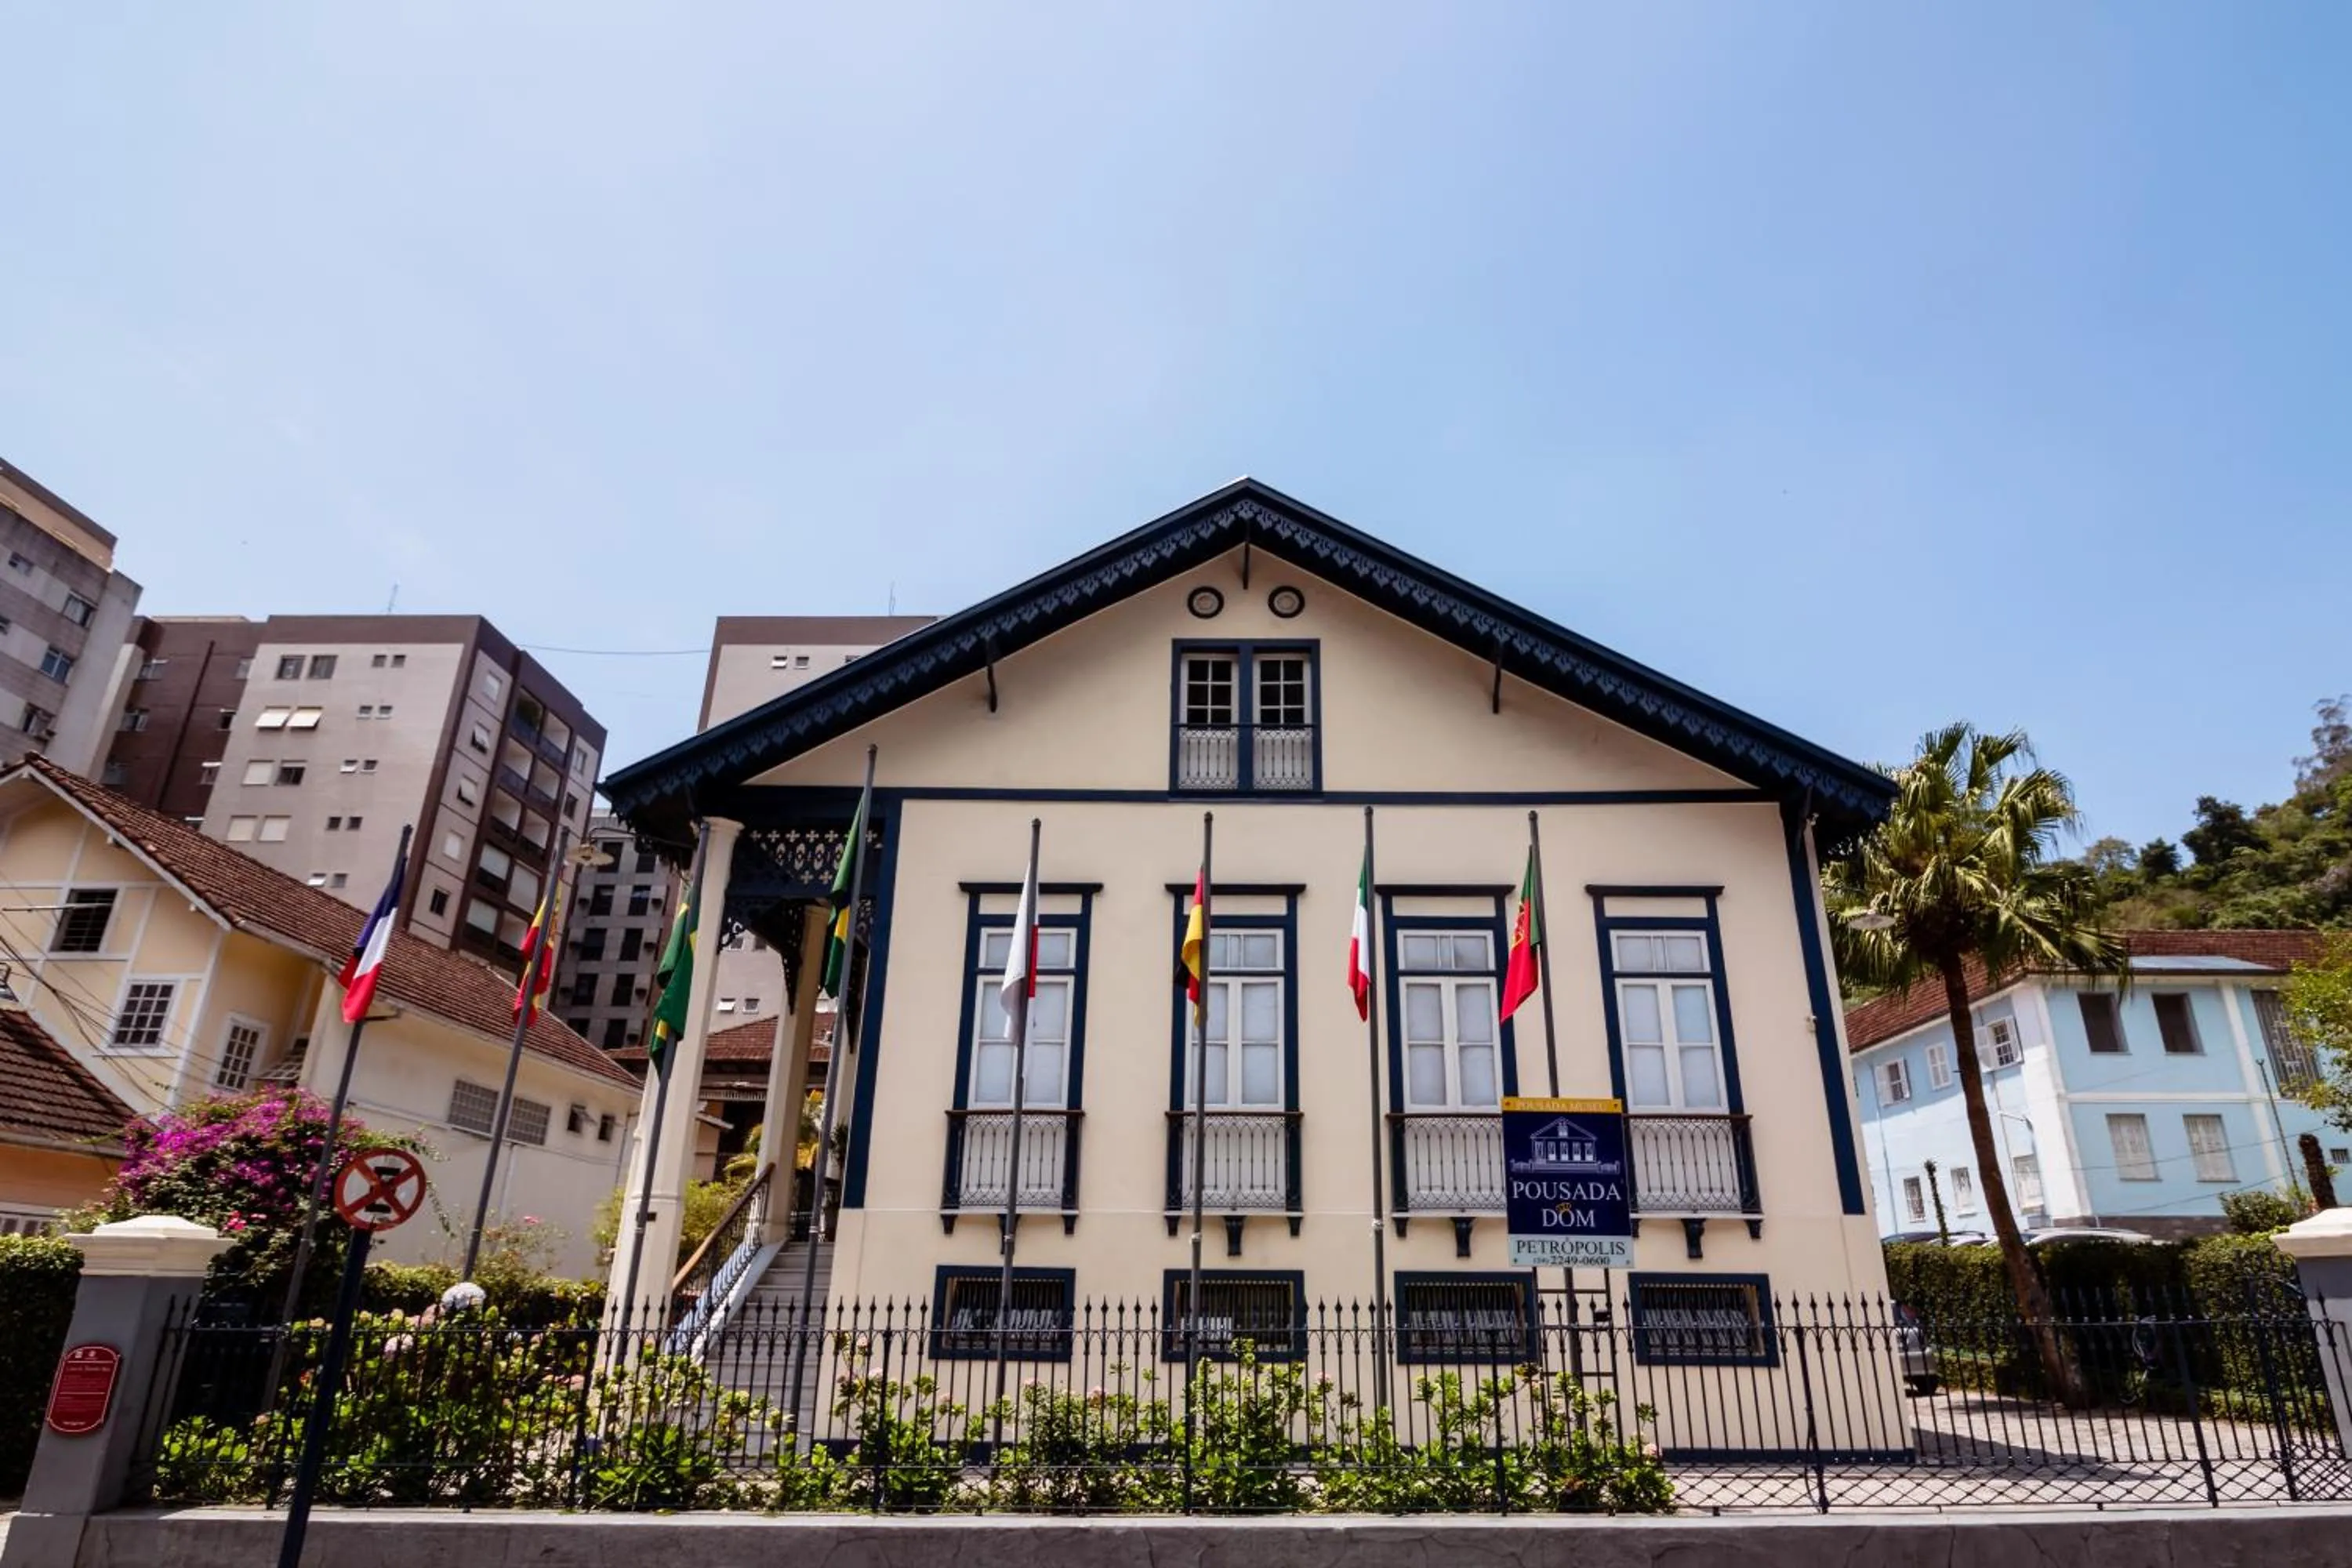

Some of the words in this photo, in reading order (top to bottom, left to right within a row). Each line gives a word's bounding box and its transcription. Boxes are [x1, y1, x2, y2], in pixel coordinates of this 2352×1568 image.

[1512, 1181, 1621, 1200] POUSADA
[1542, 1208, 1595, 1228] DOM
[1516, 1238, 1625, 1255] PETRÓPOLIS
[1551, 1254, 1610, 1265] 2249-0600
